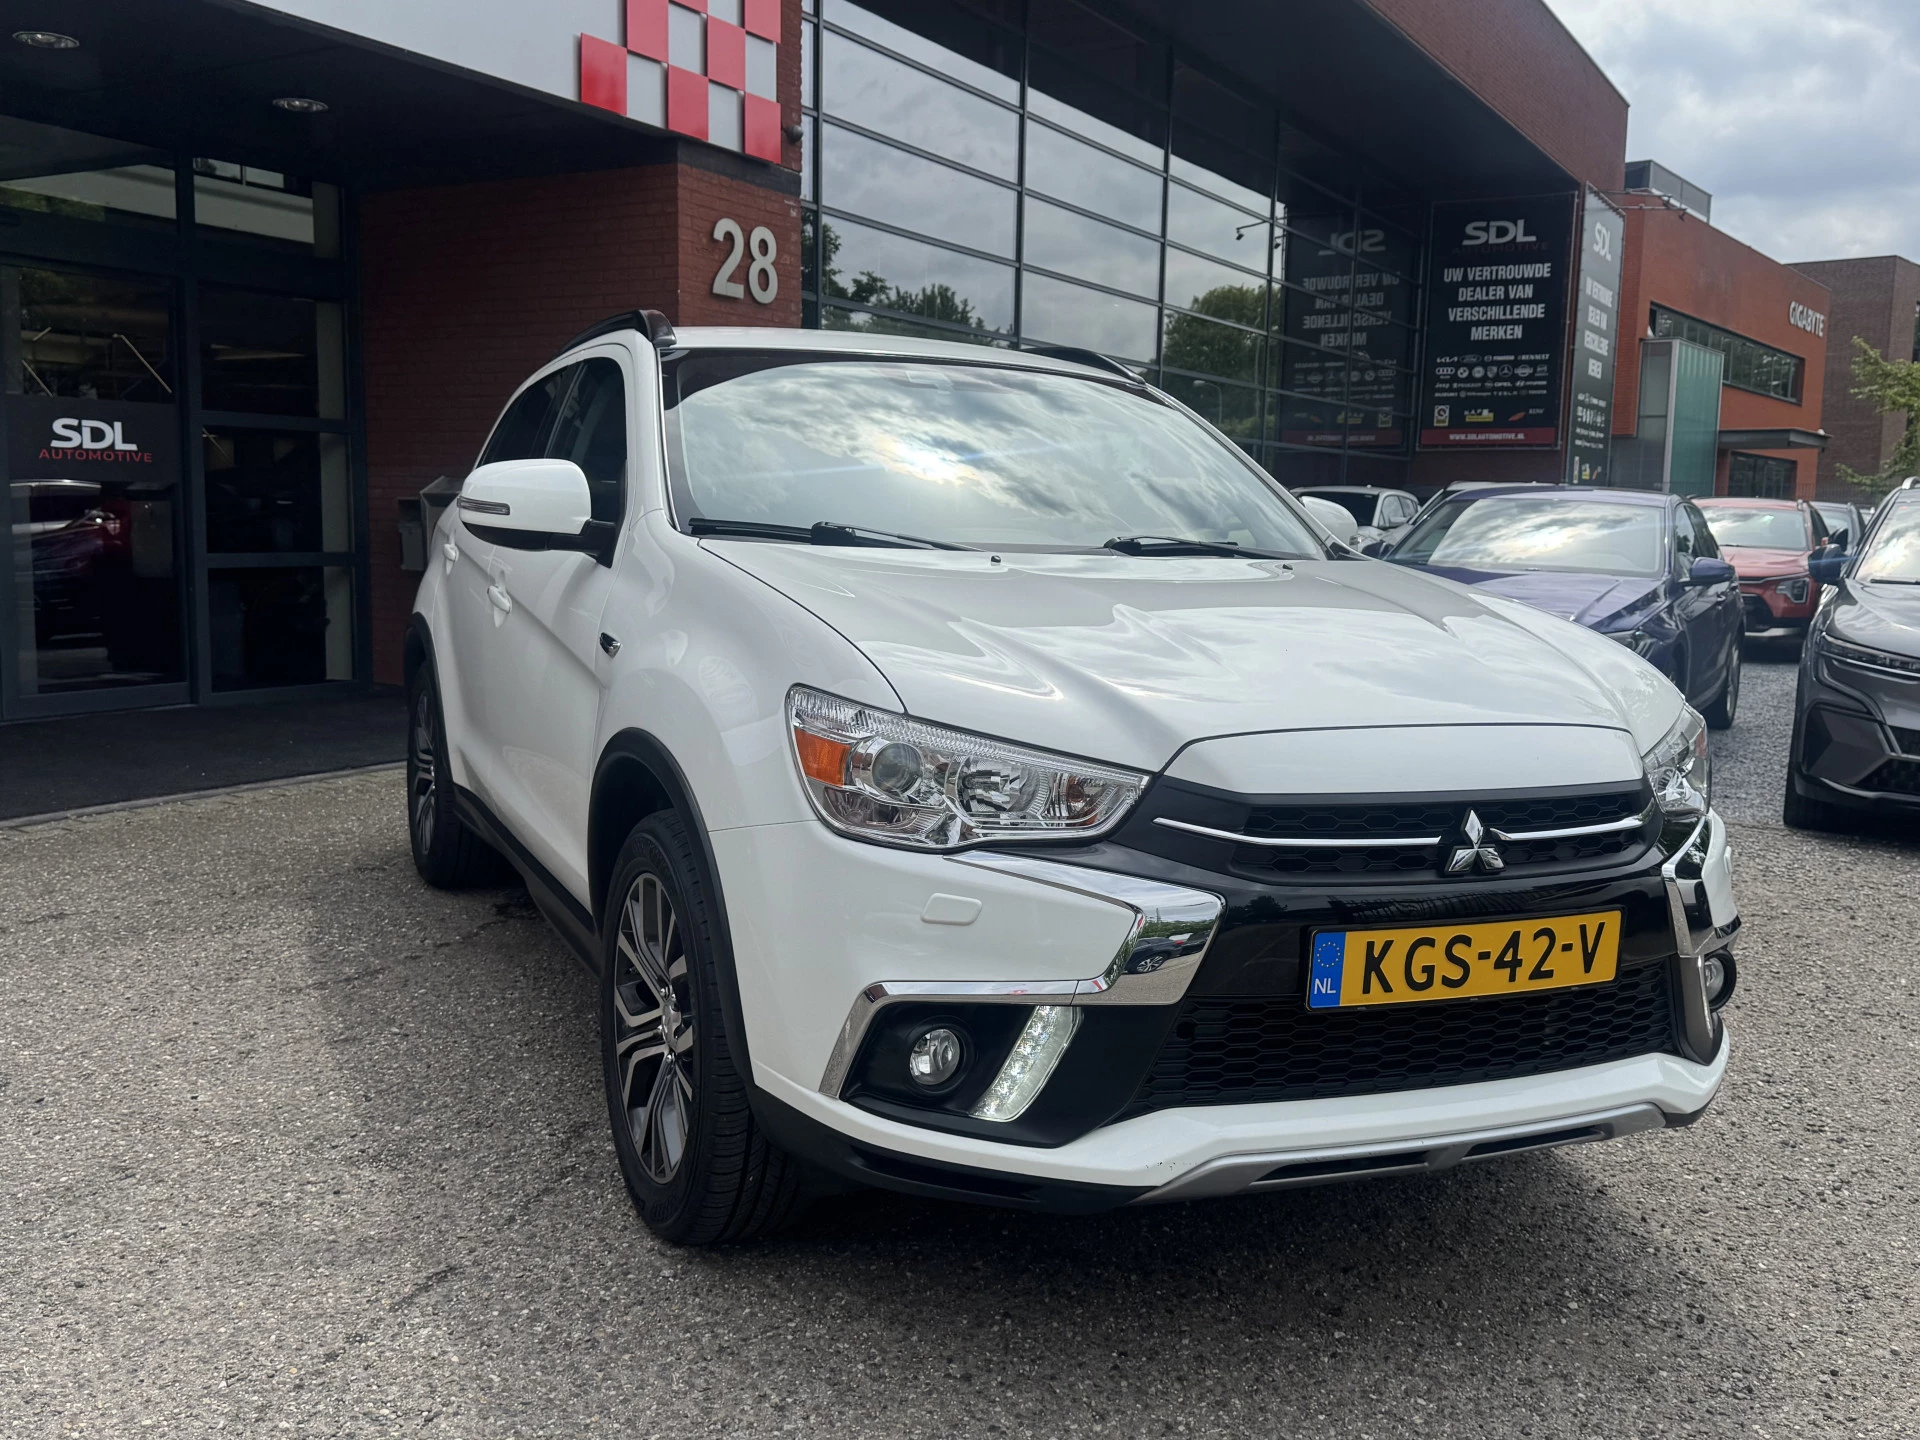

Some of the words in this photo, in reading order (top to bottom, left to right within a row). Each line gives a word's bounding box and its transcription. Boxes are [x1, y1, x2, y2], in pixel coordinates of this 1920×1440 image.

[1462, 219, 1537, 246] SDL
[1592, 222, 1612, 261] SDL
[712, 217, 778, 305] 28
[1443, 267, 1464, 283] UW
[1467, 262, 1552, 281] VERTROUWDE
[1458, 285, 1505, 302] DEALER
[1508, 284, 1533, 299] VAN
[1448, 303, 1546, 322] VERSCHILLENDE
[1789, 300, 1825, 337] GIGABYTE
[1470, 324, 1523, 341] MERKEN
[50, 418, 138, 451] SDL
[39, 448, 153, 463] AUTOMOTIVE
[1314, 977, 1337, 995] NL
[1362, 921, 1606, 995] KGS-42-V
